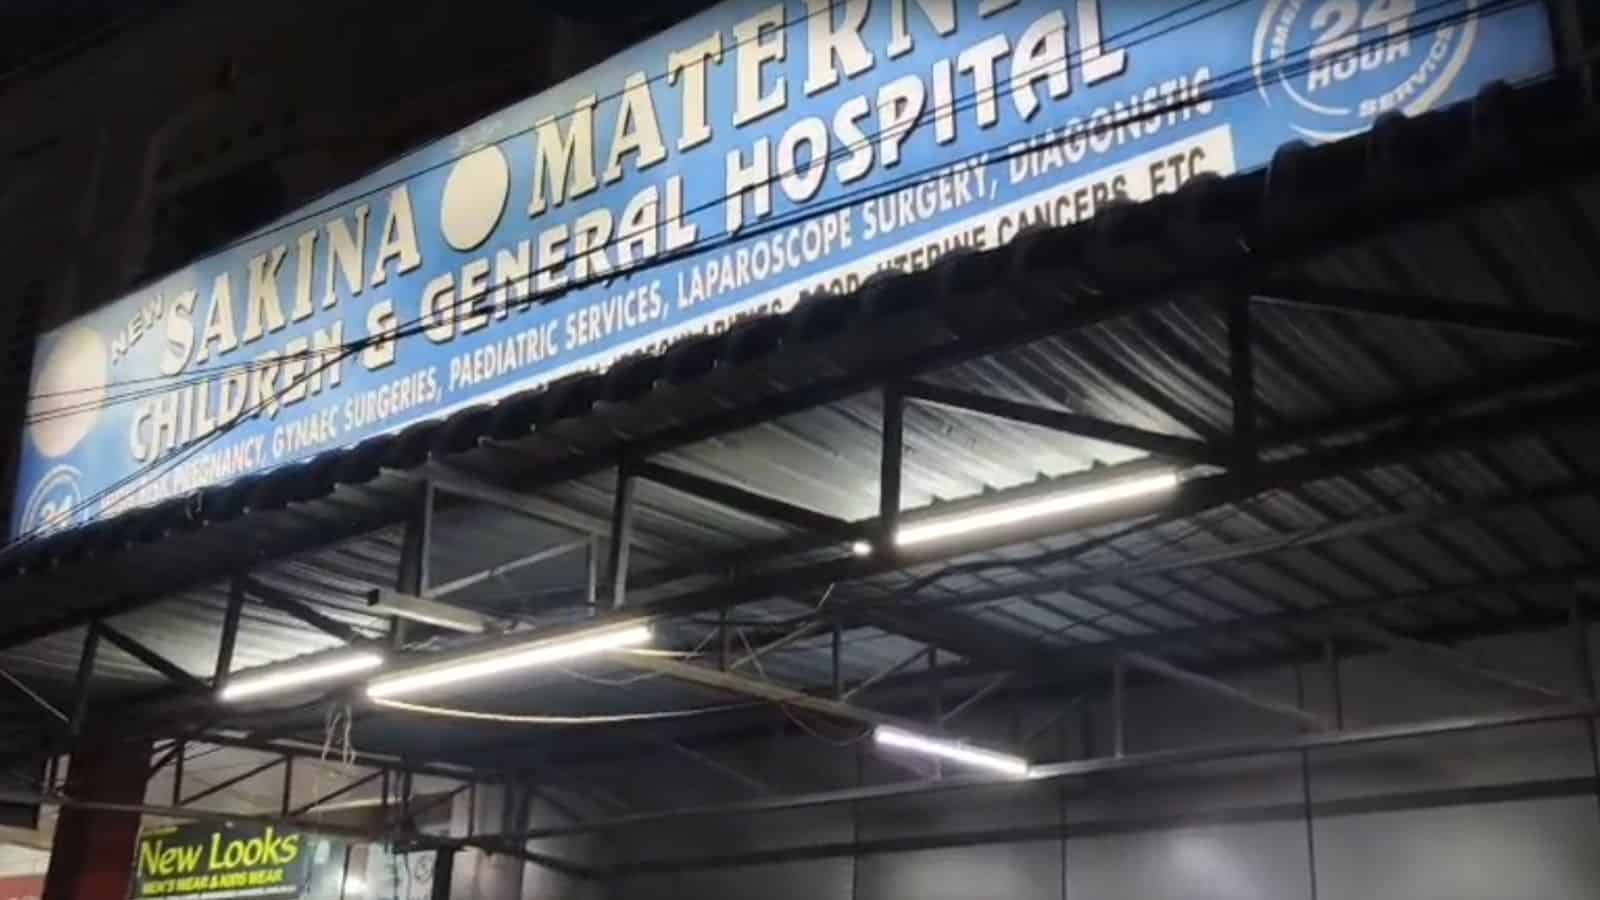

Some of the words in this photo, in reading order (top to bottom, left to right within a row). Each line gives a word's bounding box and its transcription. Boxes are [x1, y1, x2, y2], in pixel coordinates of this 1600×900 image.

[111, 294, 166, 364] NEW
[160, 185, 421, 376] SAKINA
[128, 319, 345, 464] CHILDREN
[418, 174, 698, 344] GENERAL
[723, 0, 1127, 237] HOSPITAL
[271, 419, 339, 459] GYNAEC
[343, 366, 442, 430] SURGERIES,
[449, 327, 558, 392] PAEDIATRIC
[564, 280, 669, 350] SERVICES,
[677, 207, 852, 308] LAPAROSCOPE
[861, 154, 999, 241] SURGERY,
[1007, 65, 1214, 184] DIAGONSTIC
[138, 839, 203, 877] New
[208, 825, 300, 870] Looks
